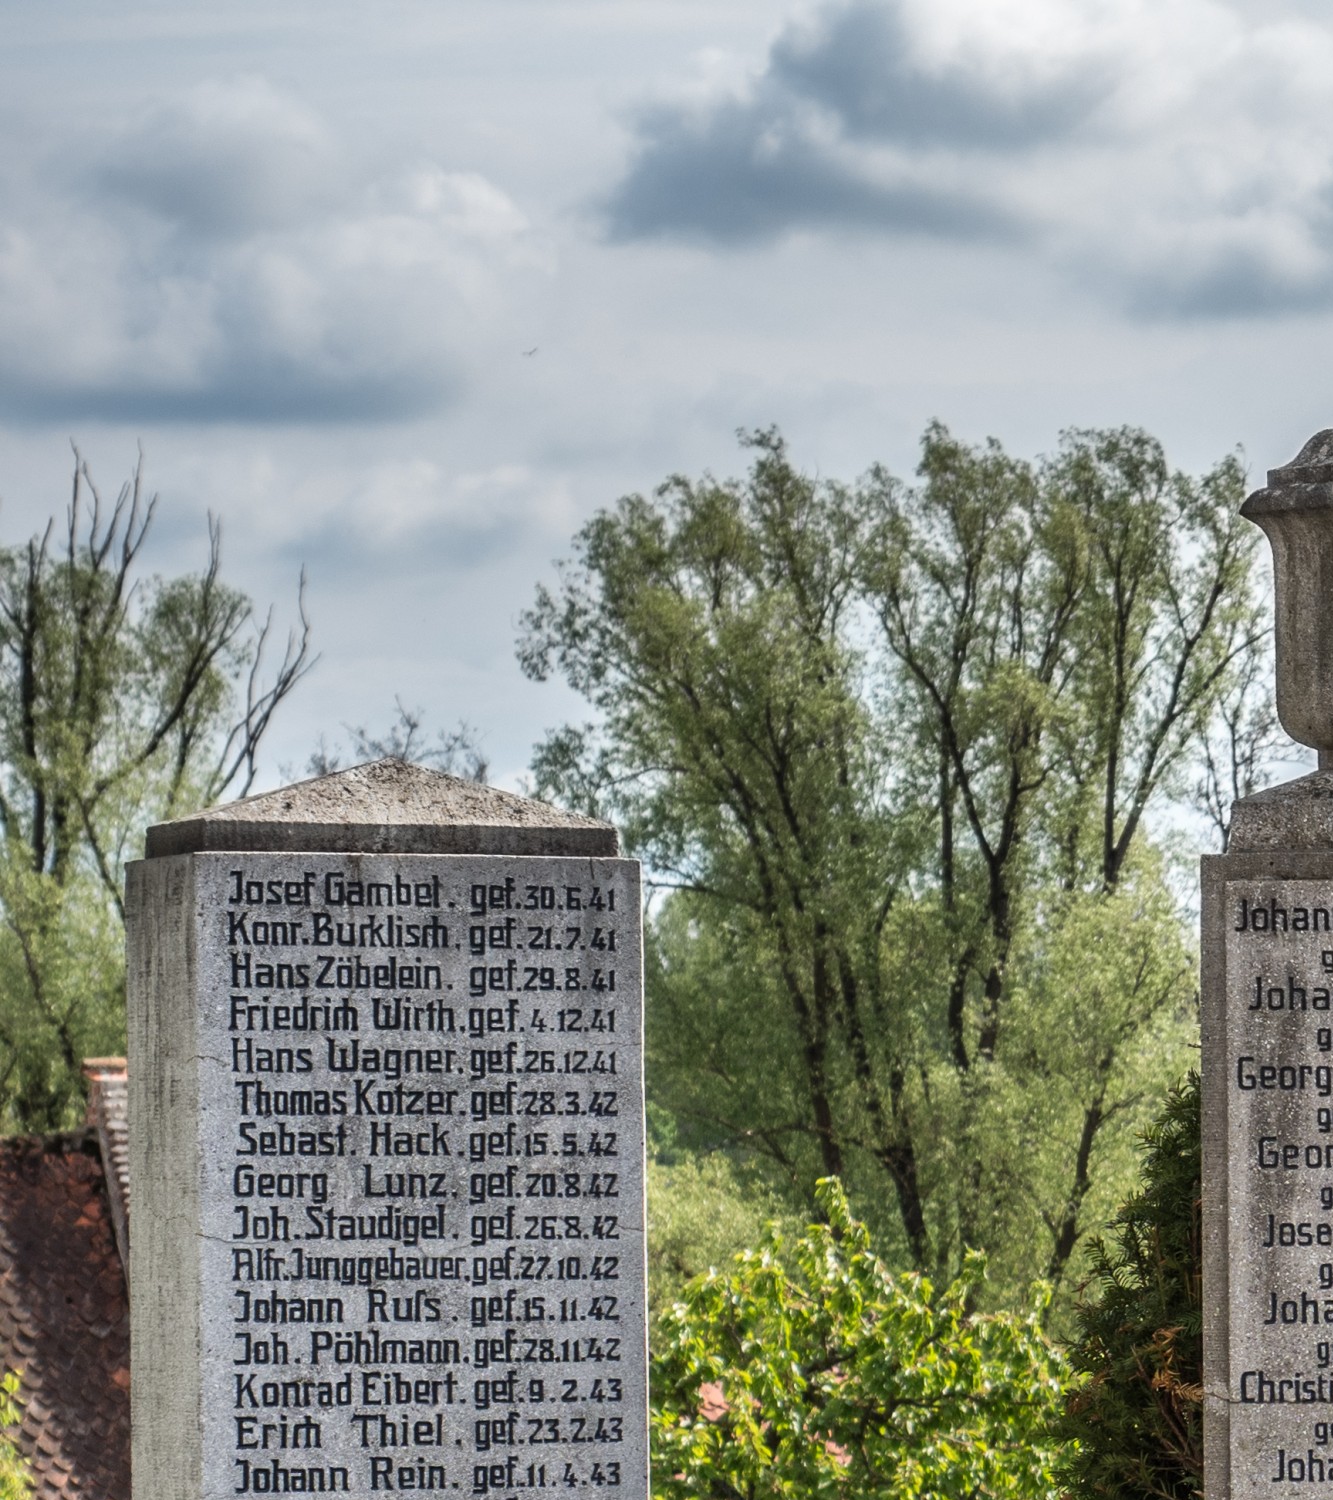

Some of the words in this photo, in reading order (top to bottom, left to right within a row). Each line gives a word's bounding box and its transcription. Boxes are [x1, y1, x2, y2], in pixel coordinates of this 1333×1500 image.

[229, 871, 315, 907] Josef
[231, 952, 309, 989] Hans
[232, 1038, 313, 1073] Hans
[1238, 1057, 1331, 1096] Georg
[235, 1080, 346, 1117] Thomas
[233, 1164, 327, 1202] Georg
[235, 1289, 342, 1323] Johann
[235, 1373, 351, 1408] Konrad
[235, 1459, 349, 1494] Johann
